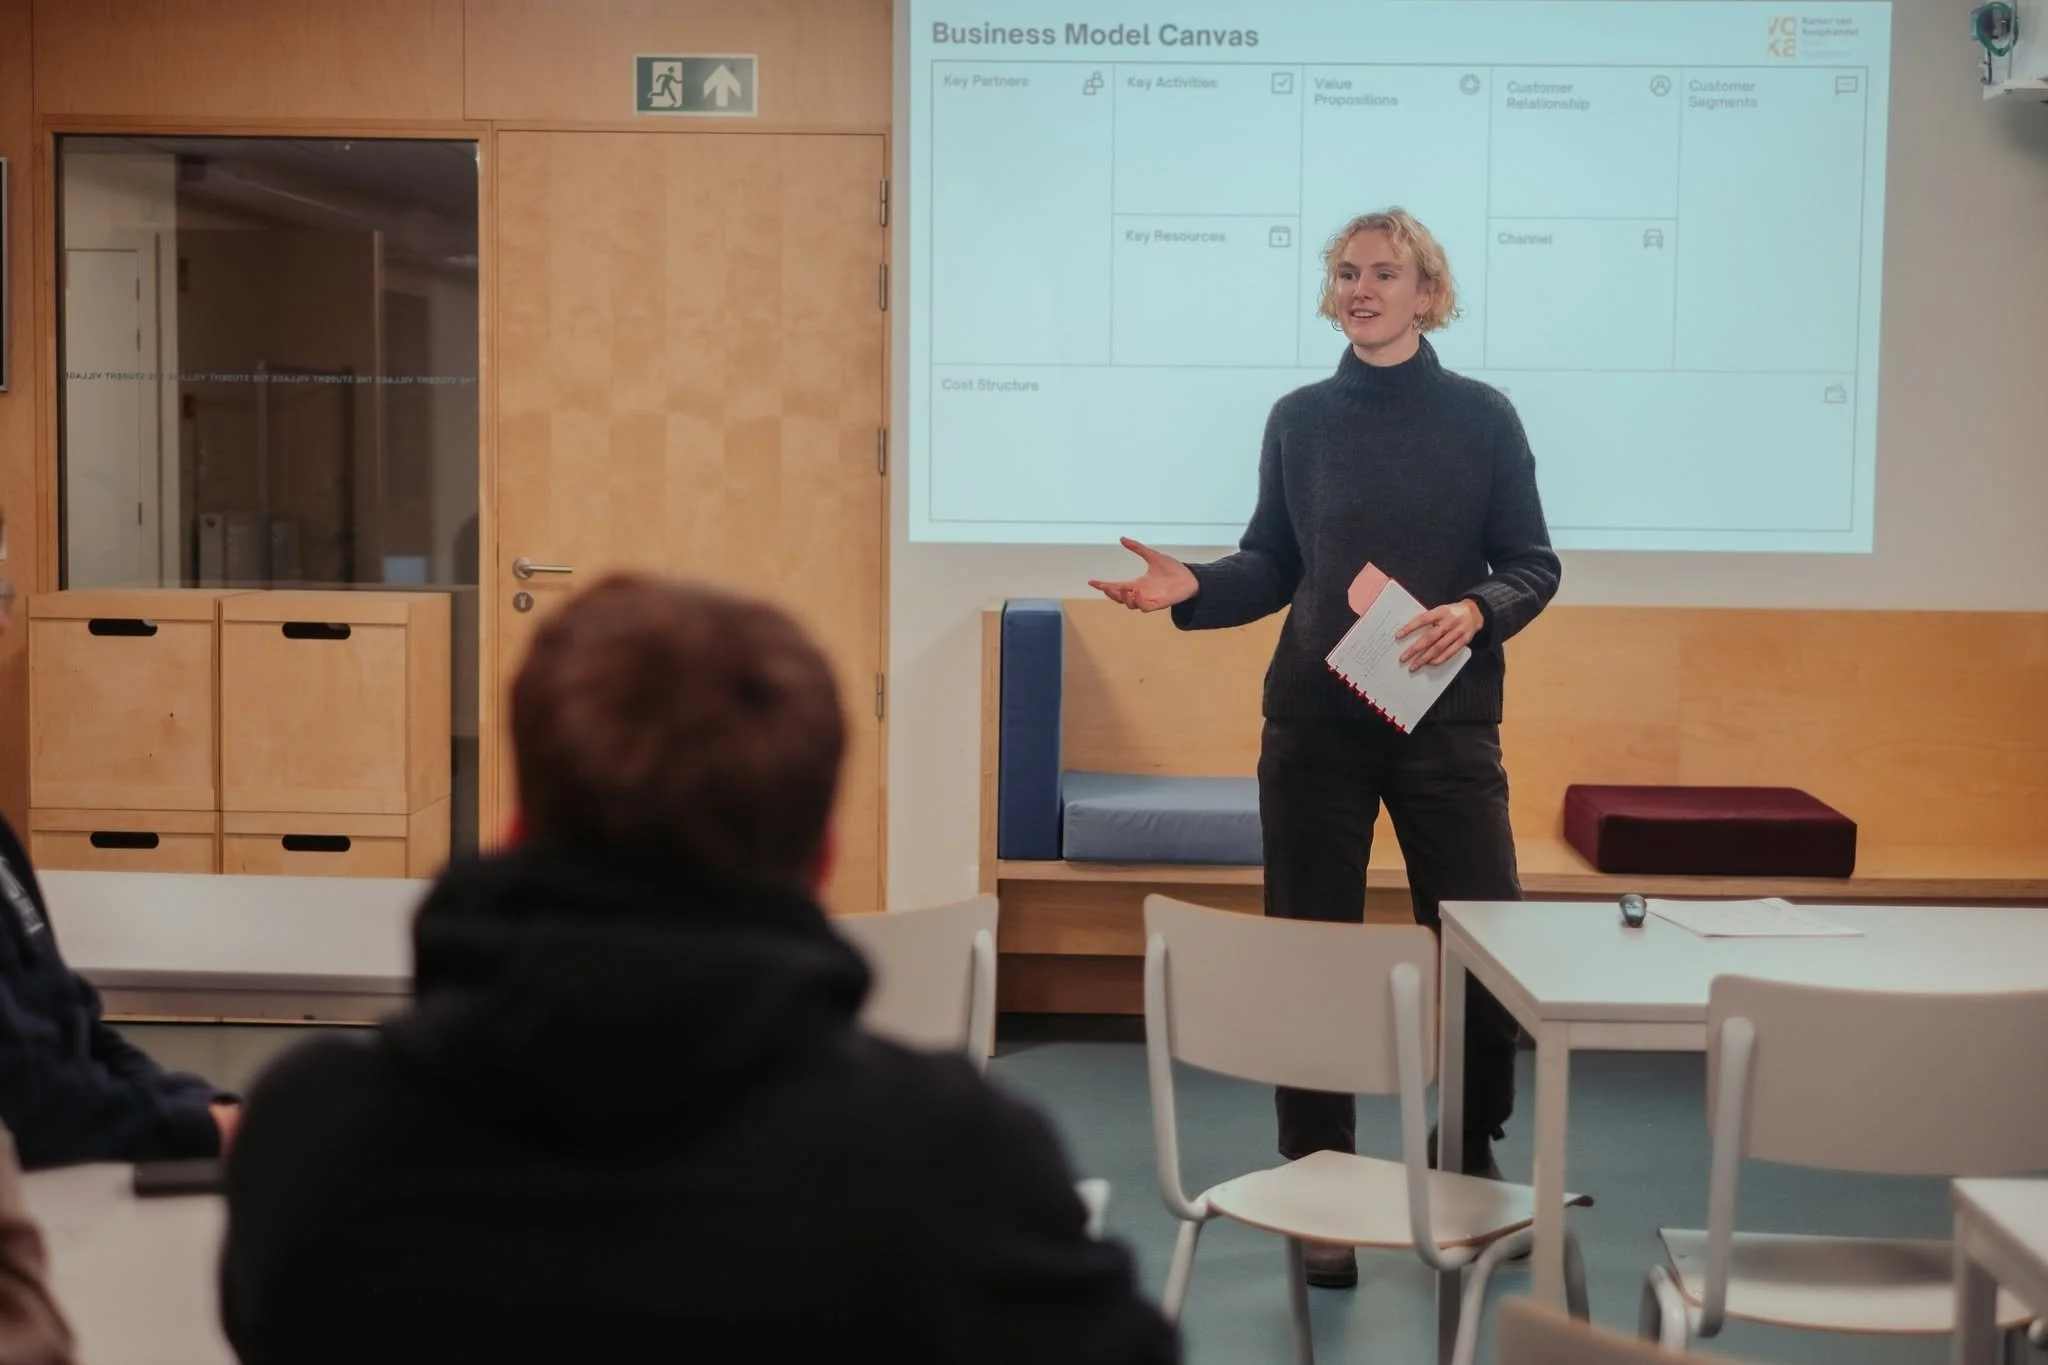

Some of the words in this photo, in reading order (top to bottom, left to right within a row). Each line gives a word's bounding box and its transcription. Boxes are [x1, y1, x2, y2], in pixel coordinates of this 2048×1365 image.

[932, 22, 1057, 45] Business
[1064, 23, 1151, 46] Model
[1159, 24, 1259, 47] Canvas
[943, 75, 968, 89] Key
[973, 75, 1029, 88] Partners
[1127, 77, 1152, 90] Key
[1155, 77, 1218, 89] Activities
[1314, 78, 1352, 90] Value
[1507, 81, 1573, 94] Customer
[1689, 80, 1756, 93] Customer
[1314, 94, 1399, 107] Propositions
[1507, 97, 1590, 111] Relationship
[1689, 96, 1758, 110] Segments
[1125, 230, 1150, 244] Key
[1154, 230, 1226, 243] Resources
[1498, 232, 1553, 245] Channel
[942, 378, 973, 391] Cost
[977, 378, 1039, 392] Structure
